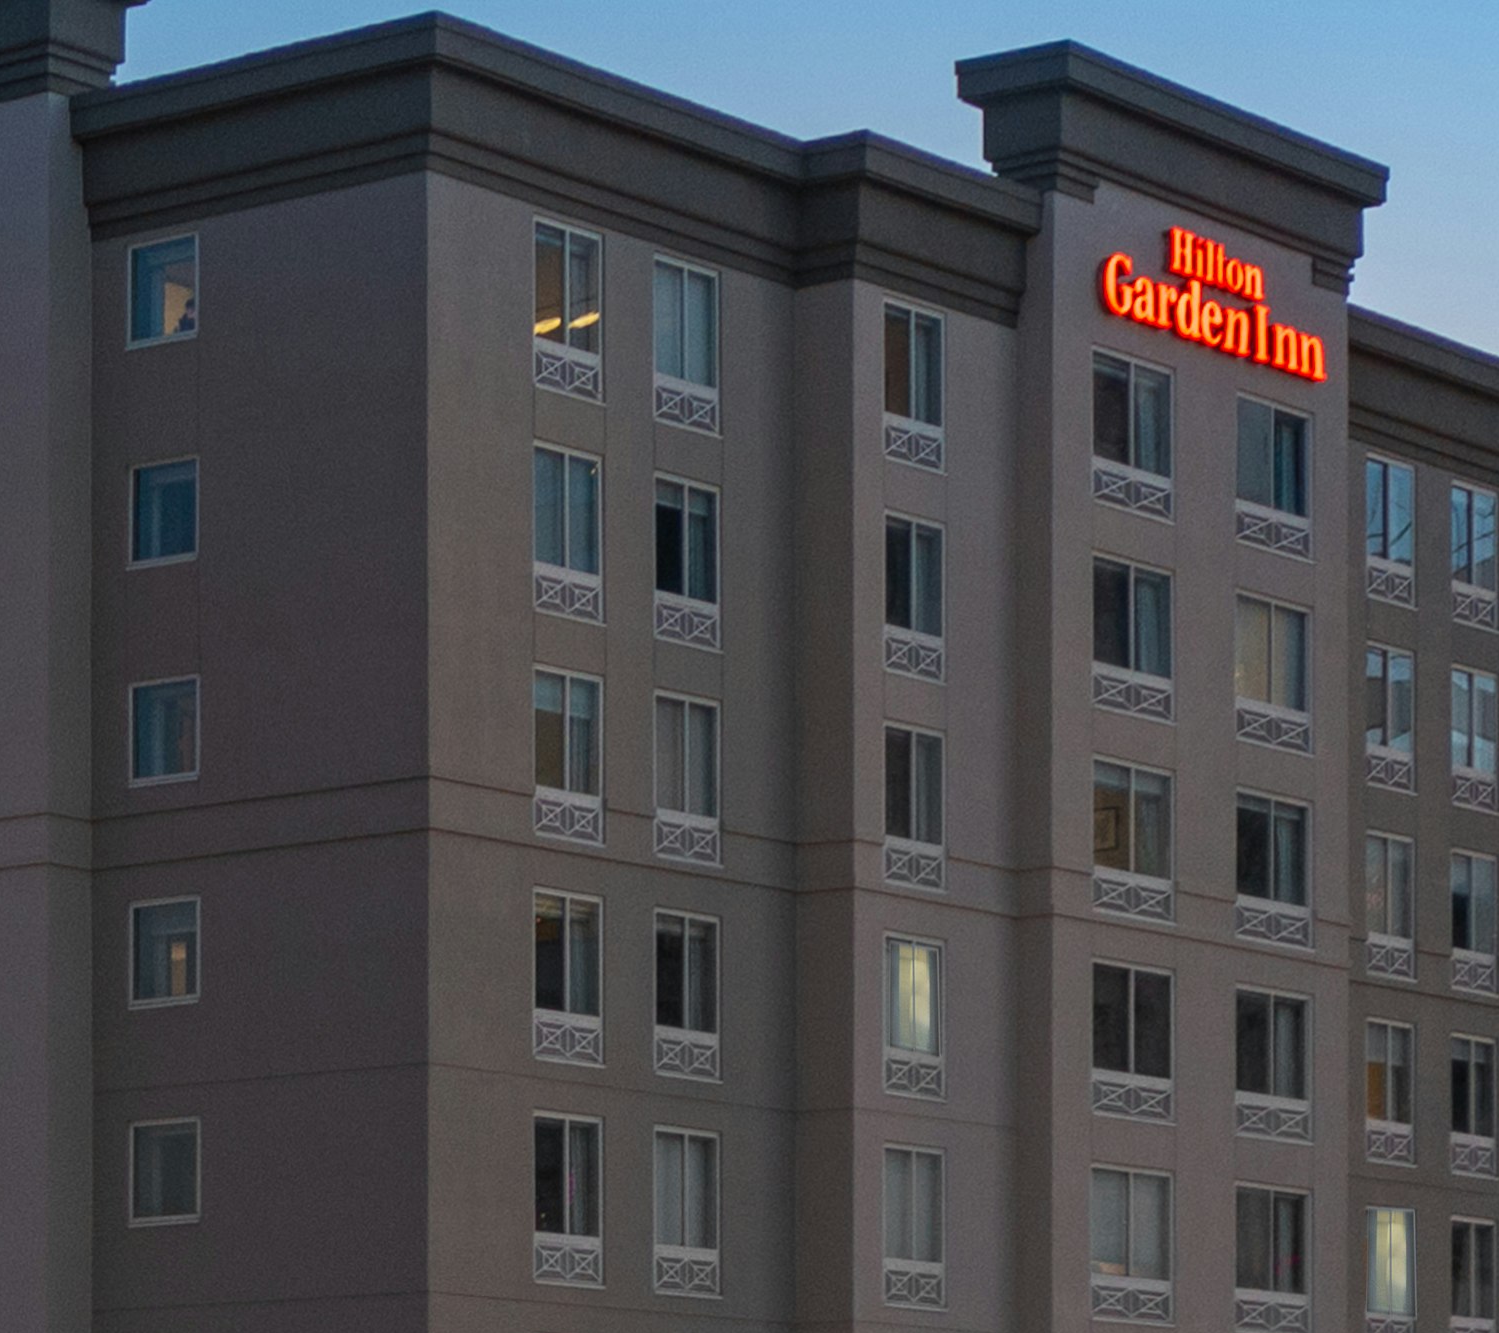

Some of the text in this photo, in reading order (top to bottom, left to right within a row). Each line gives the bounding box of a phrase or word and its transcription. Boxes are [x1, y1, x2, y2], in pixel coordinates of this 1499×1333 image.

[1168, 225, 1265, 301] Hilton
[1103, 251, 1327, 382] Garden Inn
